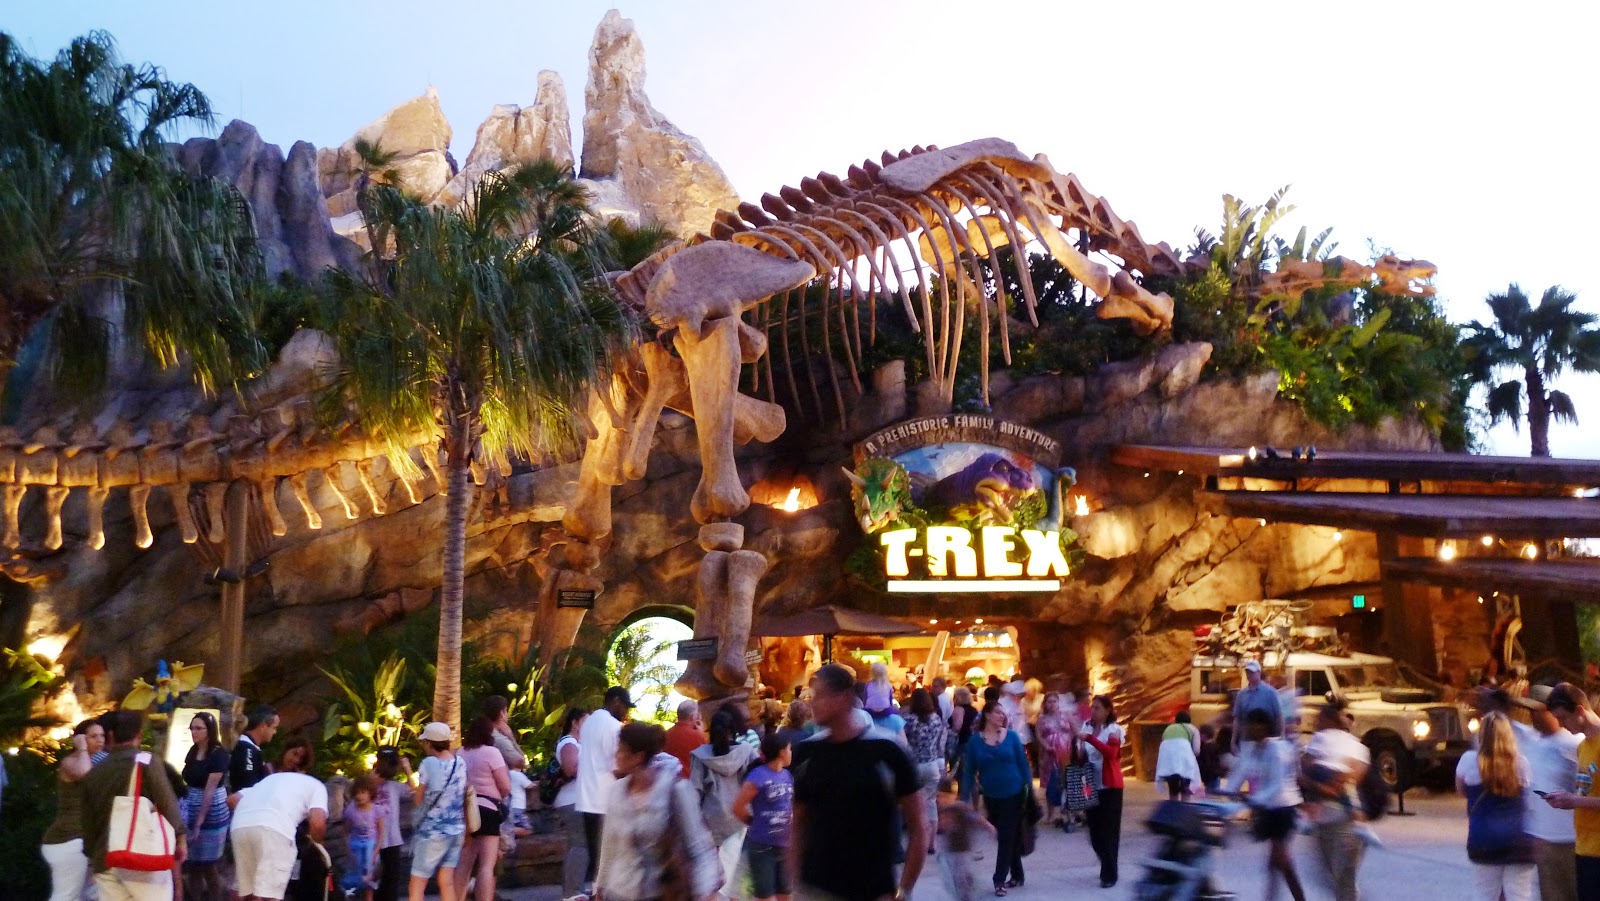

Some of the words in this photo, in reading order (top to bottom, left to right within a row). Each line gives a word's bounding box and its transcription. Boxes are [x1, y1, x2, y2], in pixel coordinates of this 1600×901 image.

[865, 442, 878, 454] A
[877, 417, 949, 447] PREHISTORIC
[954, 415, 994, 430] FAMILY
[1000, 421, 1058, 451] ADVENTURE
[880, 525, 1070, 577] T-REX
